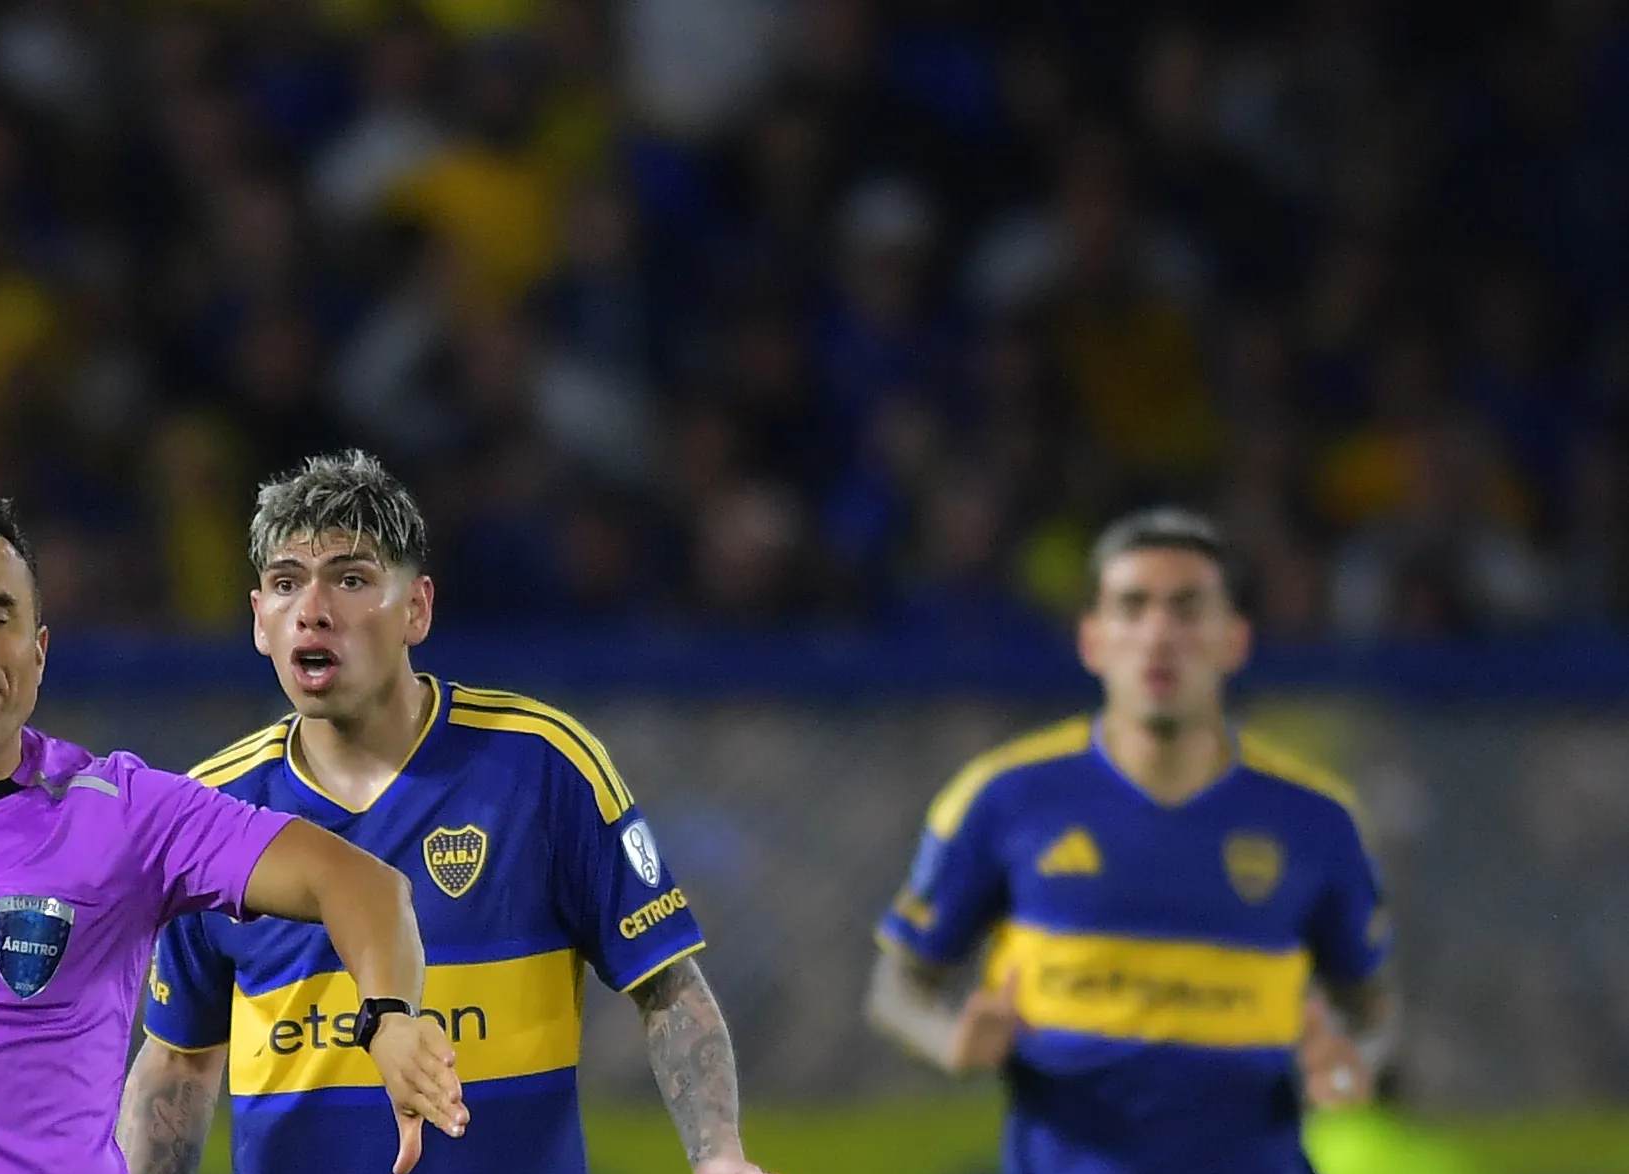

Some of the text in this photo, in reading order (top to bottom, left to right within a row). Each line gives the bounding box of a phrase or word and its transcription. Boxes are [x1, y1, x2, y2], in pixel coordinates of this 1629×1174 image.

[432, 848, 478, 866] CABJ
[619, 887, 687, 939] CETROG
[2, 936, 58, 956] ÁRBITRO
[269, 1004, 487, 1056] etsn
